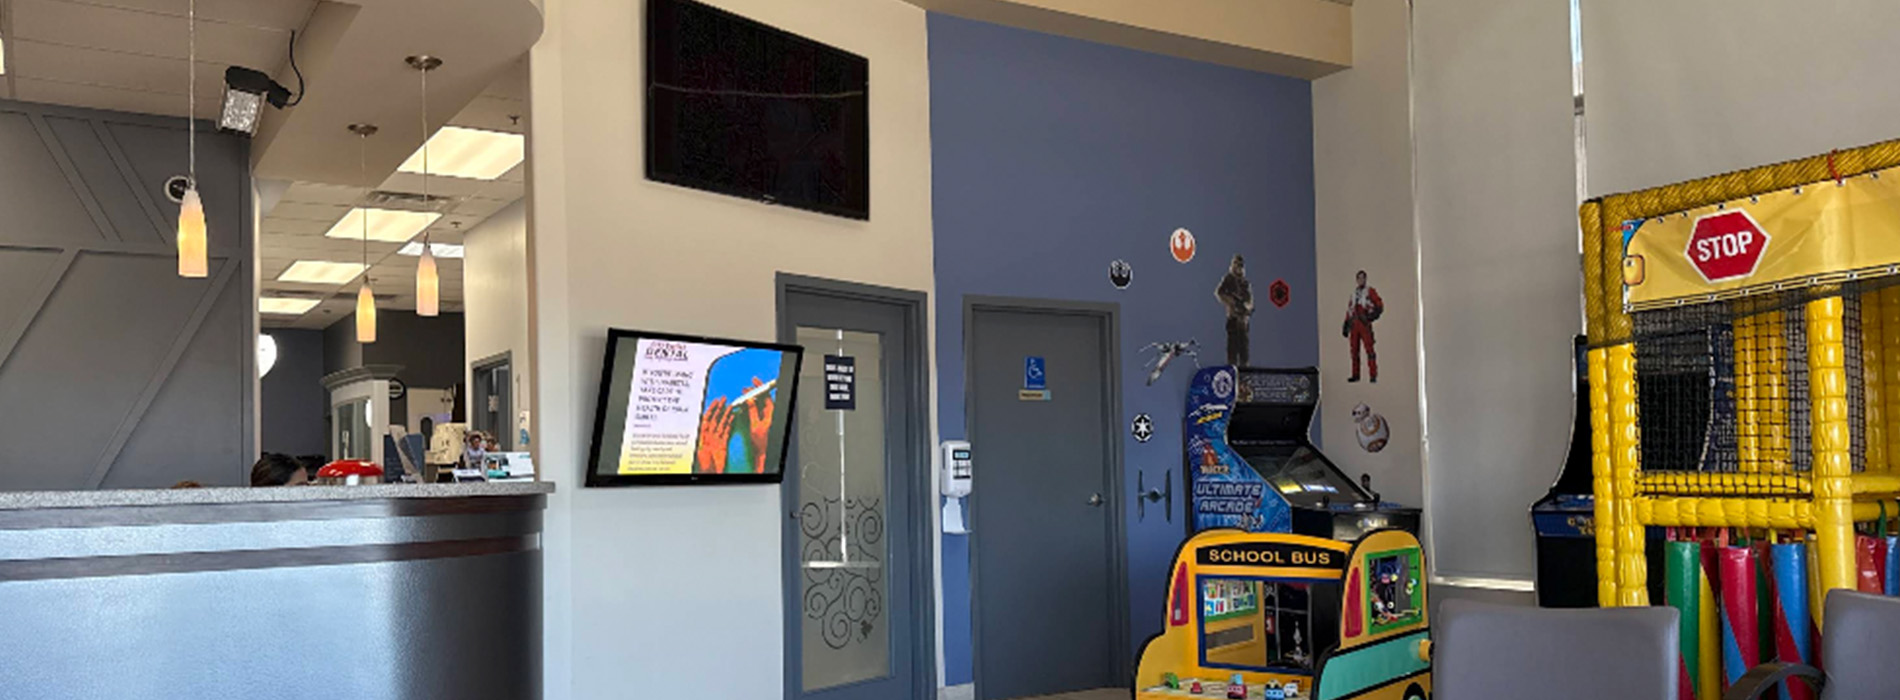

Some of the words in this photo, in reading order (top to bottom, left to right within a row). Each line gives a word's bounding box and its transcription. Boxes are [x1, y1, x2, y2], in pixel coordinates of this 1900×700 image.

[1697, 230, 1752, 261] STOP
[1196, 483, 1262, 497] ULTIMATE
[1200, 500, 1254, 513] ARCADE
[1209, 549, 1285, 563] SCHOOL
[1291, 551, 1330, 564] BUS
